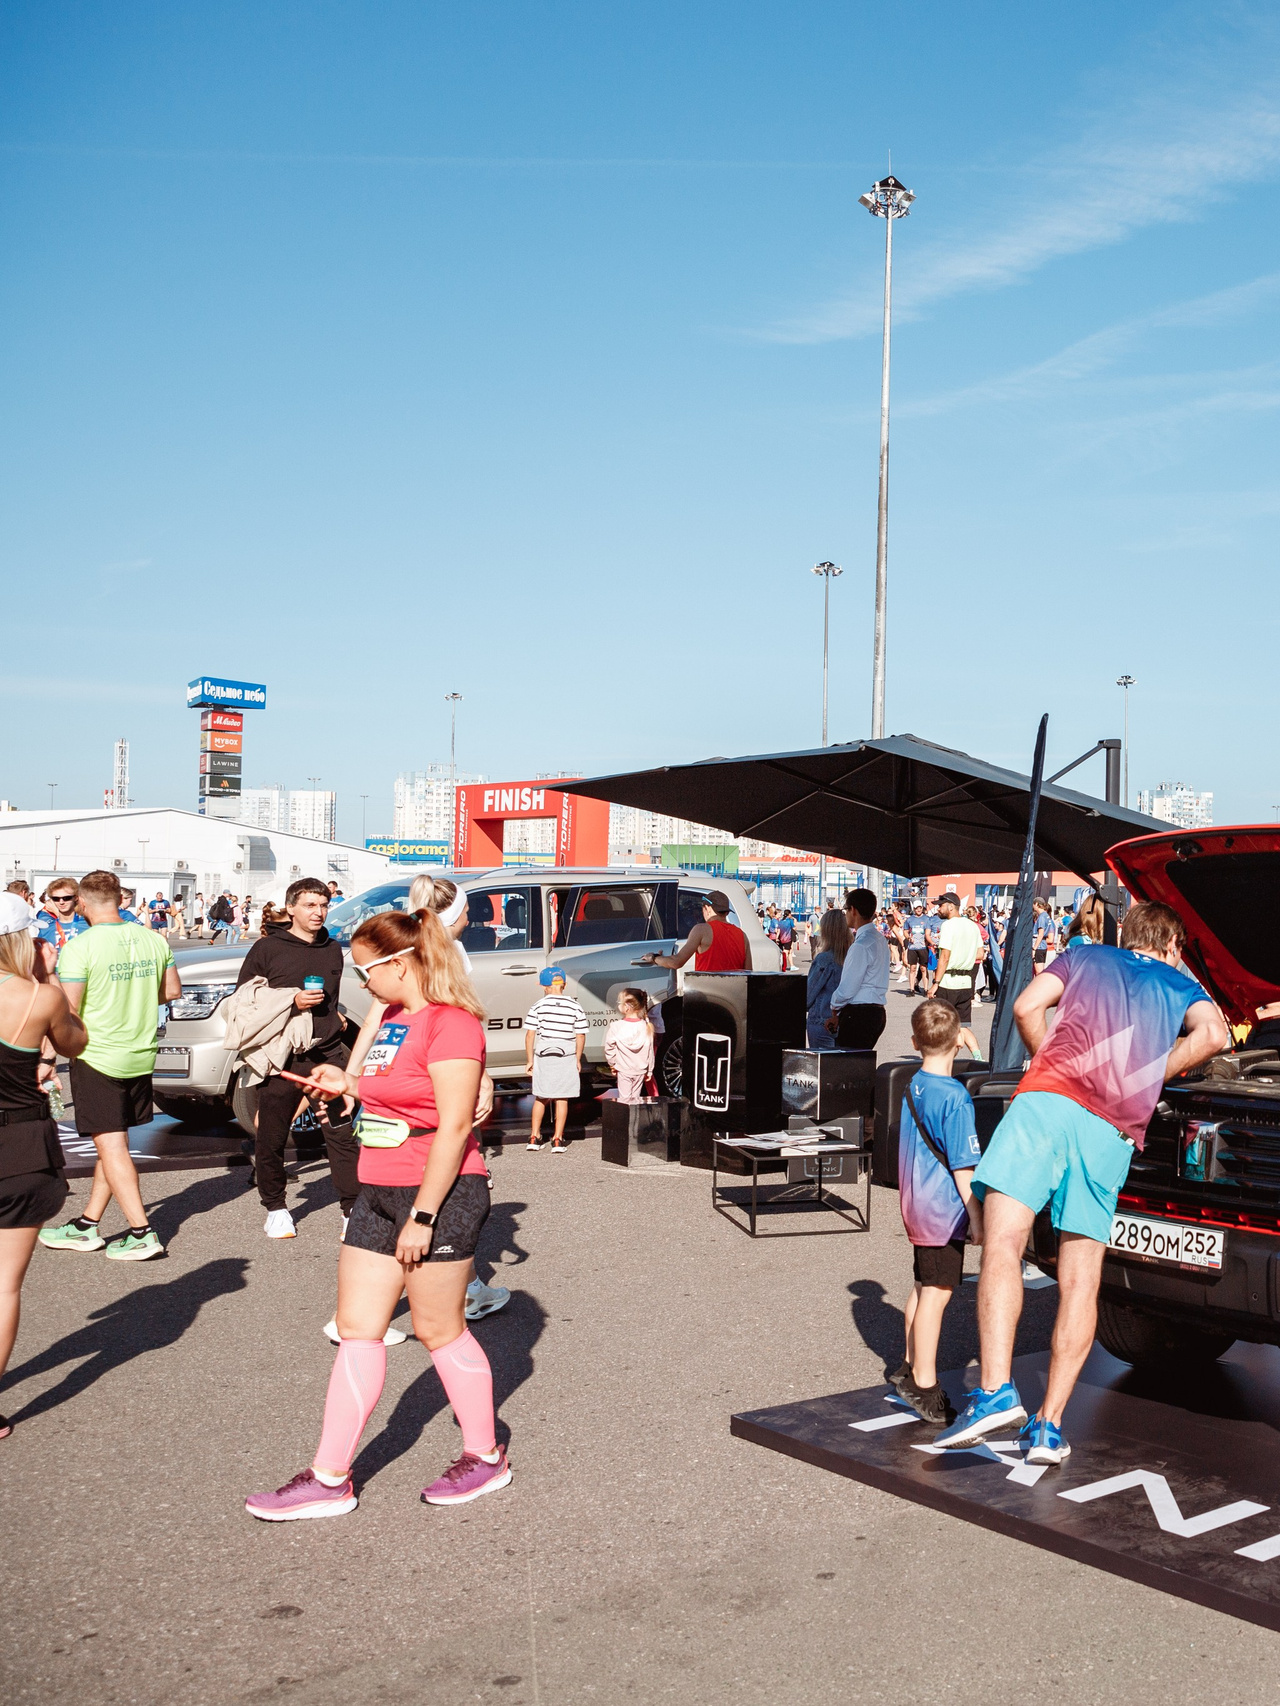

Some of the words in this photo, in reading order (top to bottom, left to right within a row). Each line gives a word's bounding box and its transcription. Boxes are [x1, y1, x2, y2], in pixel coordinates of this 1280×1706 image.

[204, 681, 243, 700] Седьмое
[244, 687, 266, 703] небо
[213, 715, 241, 727] М.видео
[214, 737, 239, 746] MYBOX
[212, 760, 239, 768] LAWINE
[483, 787, 545, 812] FINISH
[458, 790, 466, 851] TORERO
[368, 842, 448, 856] castorama
[593, 1019, 608, 1027] 200
[786, 1077, 814, 1089] TANK
[700, 1093, 724, 1103] TANK
[1109, 1220, 1180, 1258] 289ОМ
[1184, 1231, 1216, 1256] 252
[1141, 1255, 1160, 1264] TANK
[1191, 1255, 1208, 1265] RUS
